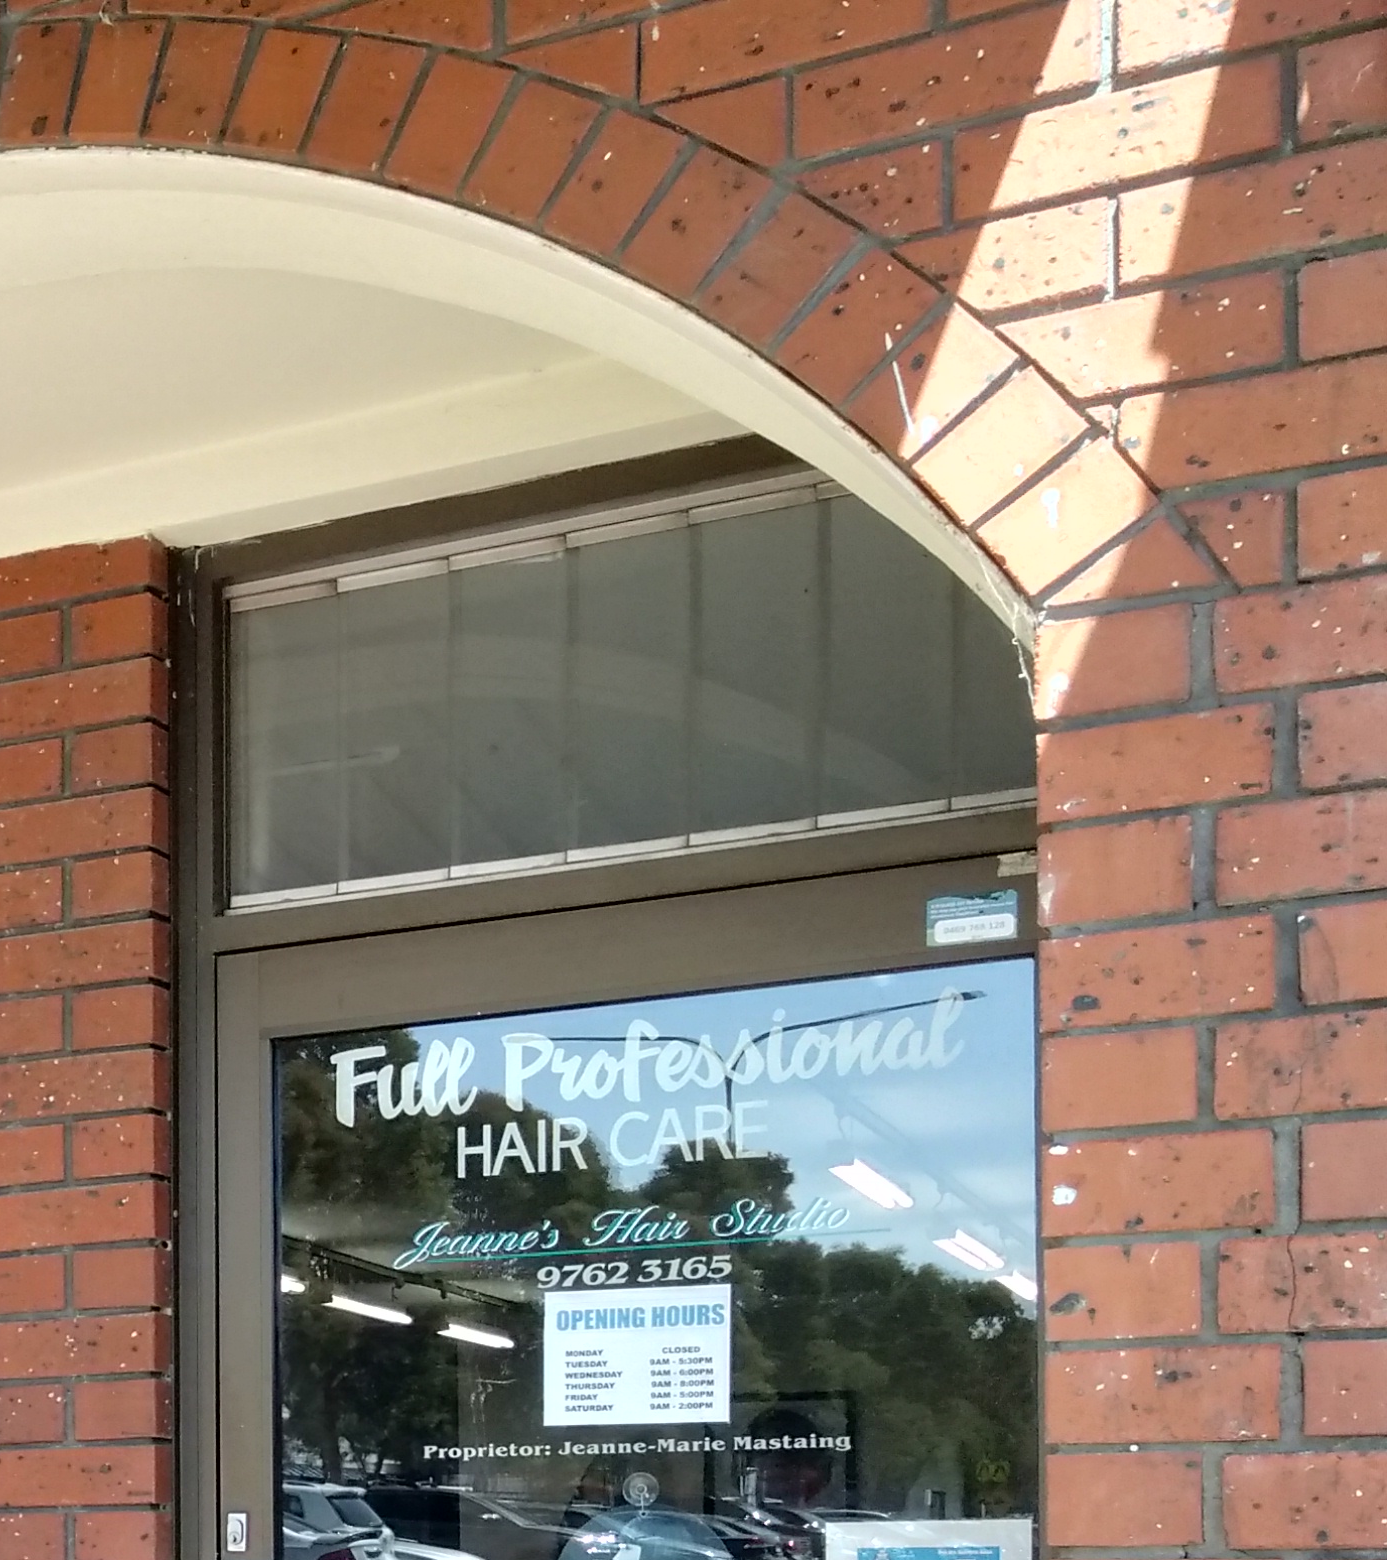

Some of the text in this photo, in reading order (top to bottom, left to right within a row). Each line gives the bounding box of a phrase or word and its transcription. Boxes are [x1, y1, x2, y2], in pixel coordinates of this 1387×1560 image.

[330, 986, 965, 1128] Full Professional
[457, 1099, 769, 1179] HAIR CARE
[393, 1196, 851, 1269] Jeanne's Hair Studio
[536, 1255, 733, 1289] 9762 3165
[556, 1303, 725, 1331] OPENING HOURS
[565, 1346, 701, 1357] MONDAY CLOSED
[565, 1360, 608, 1368] TUESDAY
[649, 1358, 670, 1367] 9AM
[678, 1357, 713, 1366] 5:30PM
[565, 1371, 623, 1380] WEDNESDAY
[650, 1370, 671, 1378] 9AM
[679, 1369, 714, 1377] 6:00PM
[565, 1382, 615, 1390] THURSDAY
[651, 1381, 672, 1389] 9AM
[680, 1380, 715, 1388] 8:00PM
[565, 1393, 598, 1401] FRIDAY
[650, 1392, 671, 1400] 9AM
[679, 1391, 714, 1399] 5:00PM
[565, 1404, 614, 1413] SATURDAY
[649, 1403, 670, 1411] 9AM
[678, 1402, 714, 1410] 2:00PM
[423, 1434, 851, 1462] Proprietor: Jeanne-Marie Mastaing
